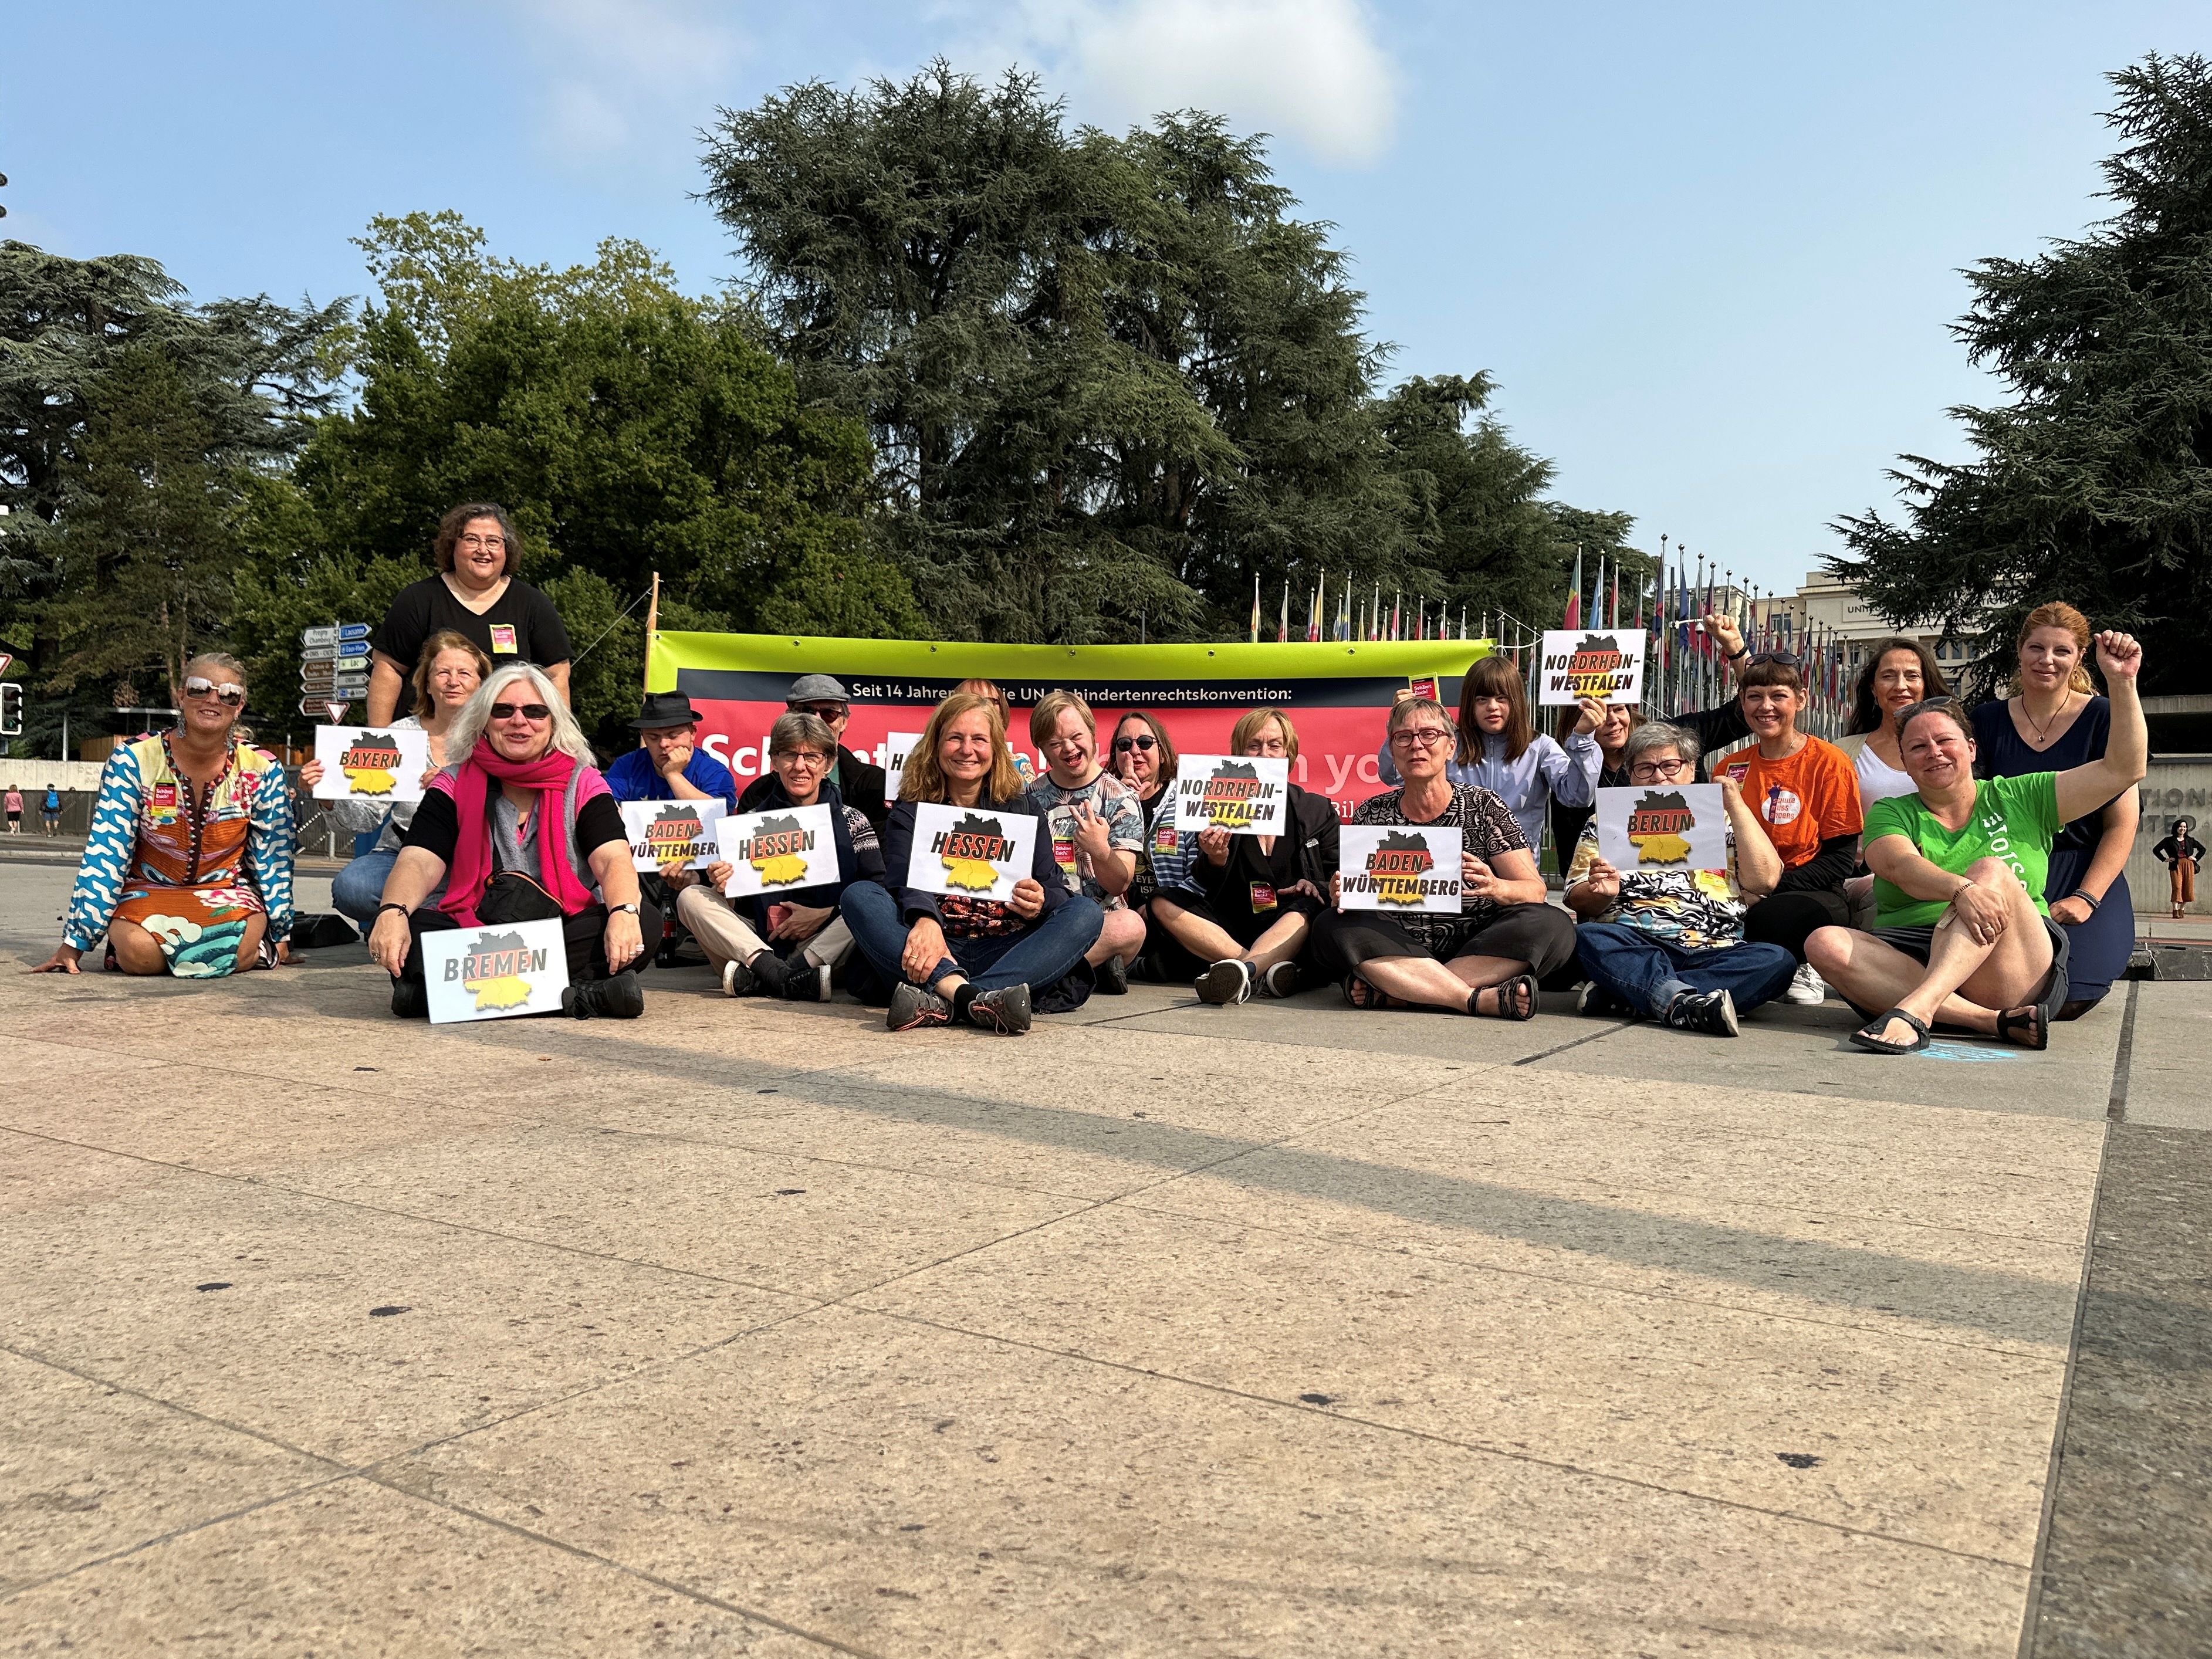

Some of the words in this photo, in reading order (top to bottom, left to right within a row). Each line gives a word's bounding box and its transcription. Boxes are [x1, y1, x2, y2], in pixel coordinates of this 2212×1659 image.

[1544, 654, 1641, 671] NORDRHEIN-
[853, 683, 882, 698] Seit
[887, 685, 902, 697] 14
[998, 688, 1010, 700] ie
[1550, 674, 1633, 690] WESTFALEN
[339, 750, 402, 768] BAYERN
[1324, 753, 1379, 795] yo
[1180, 779, 1283, 800] NORDRHEIN-
[2139, 788, 2205, 808] TION
[1186, 801, 1276, 821] WESTFALEN
[645, 823, 703, 838] BADEN-
[1627, 814, 1693, 833] BERLIN
[2139, 815, 2196, 832] ITED
[630, 842, 719, 858] ÜRTTEMBER
[739, 830, 816, 861] HESSEN
[931, 831, 1016, 863] HESSEN
[1365, 853, 1434, 872] BADEN-
[1342, 873, 1459, 897] WÜRTTEMBERG
[444, 948, 547, 982] BREMEN
